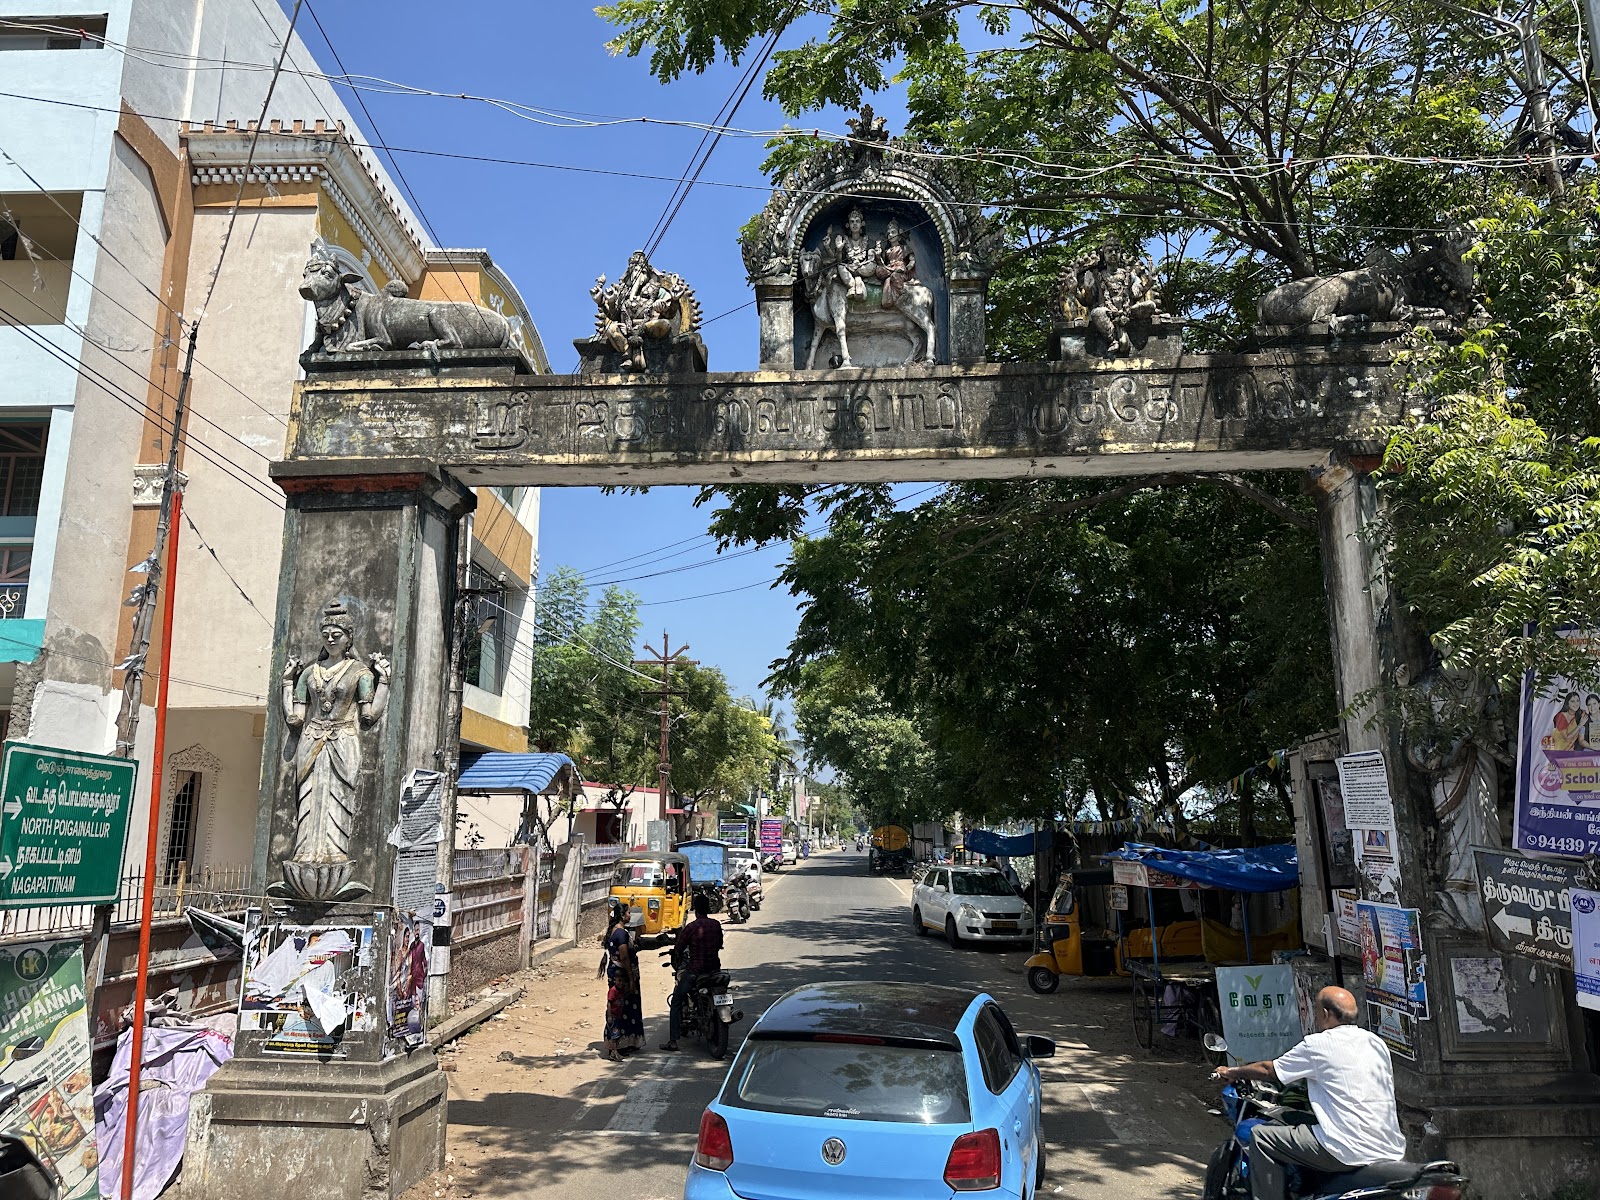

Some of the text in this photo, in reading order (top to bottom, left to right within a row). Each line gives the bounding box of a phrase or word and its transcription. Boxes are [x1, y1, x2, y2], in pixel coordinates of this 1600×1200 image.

[1565, 772, 1600, 785] Schol
[26, 780, 121, 817] வடக்கு பொய்கைநல்லூர்
[1529, 806, 1573, 820] இந்தியன்
[21, 817, 110, 838] NORTH POIGAINALLUR
[1538, 835, 1600, 854] 94439 7
[14, 839, 81, 873] நாகப்பட்டினம்
[11, 876, 76, 894] NAGAPATTINAM
[4, 977, 62, 1011] HOTEL
[1229, 992, 1285, 1008] வேதா
[0, 983, 84, 1034] UPPANNA
